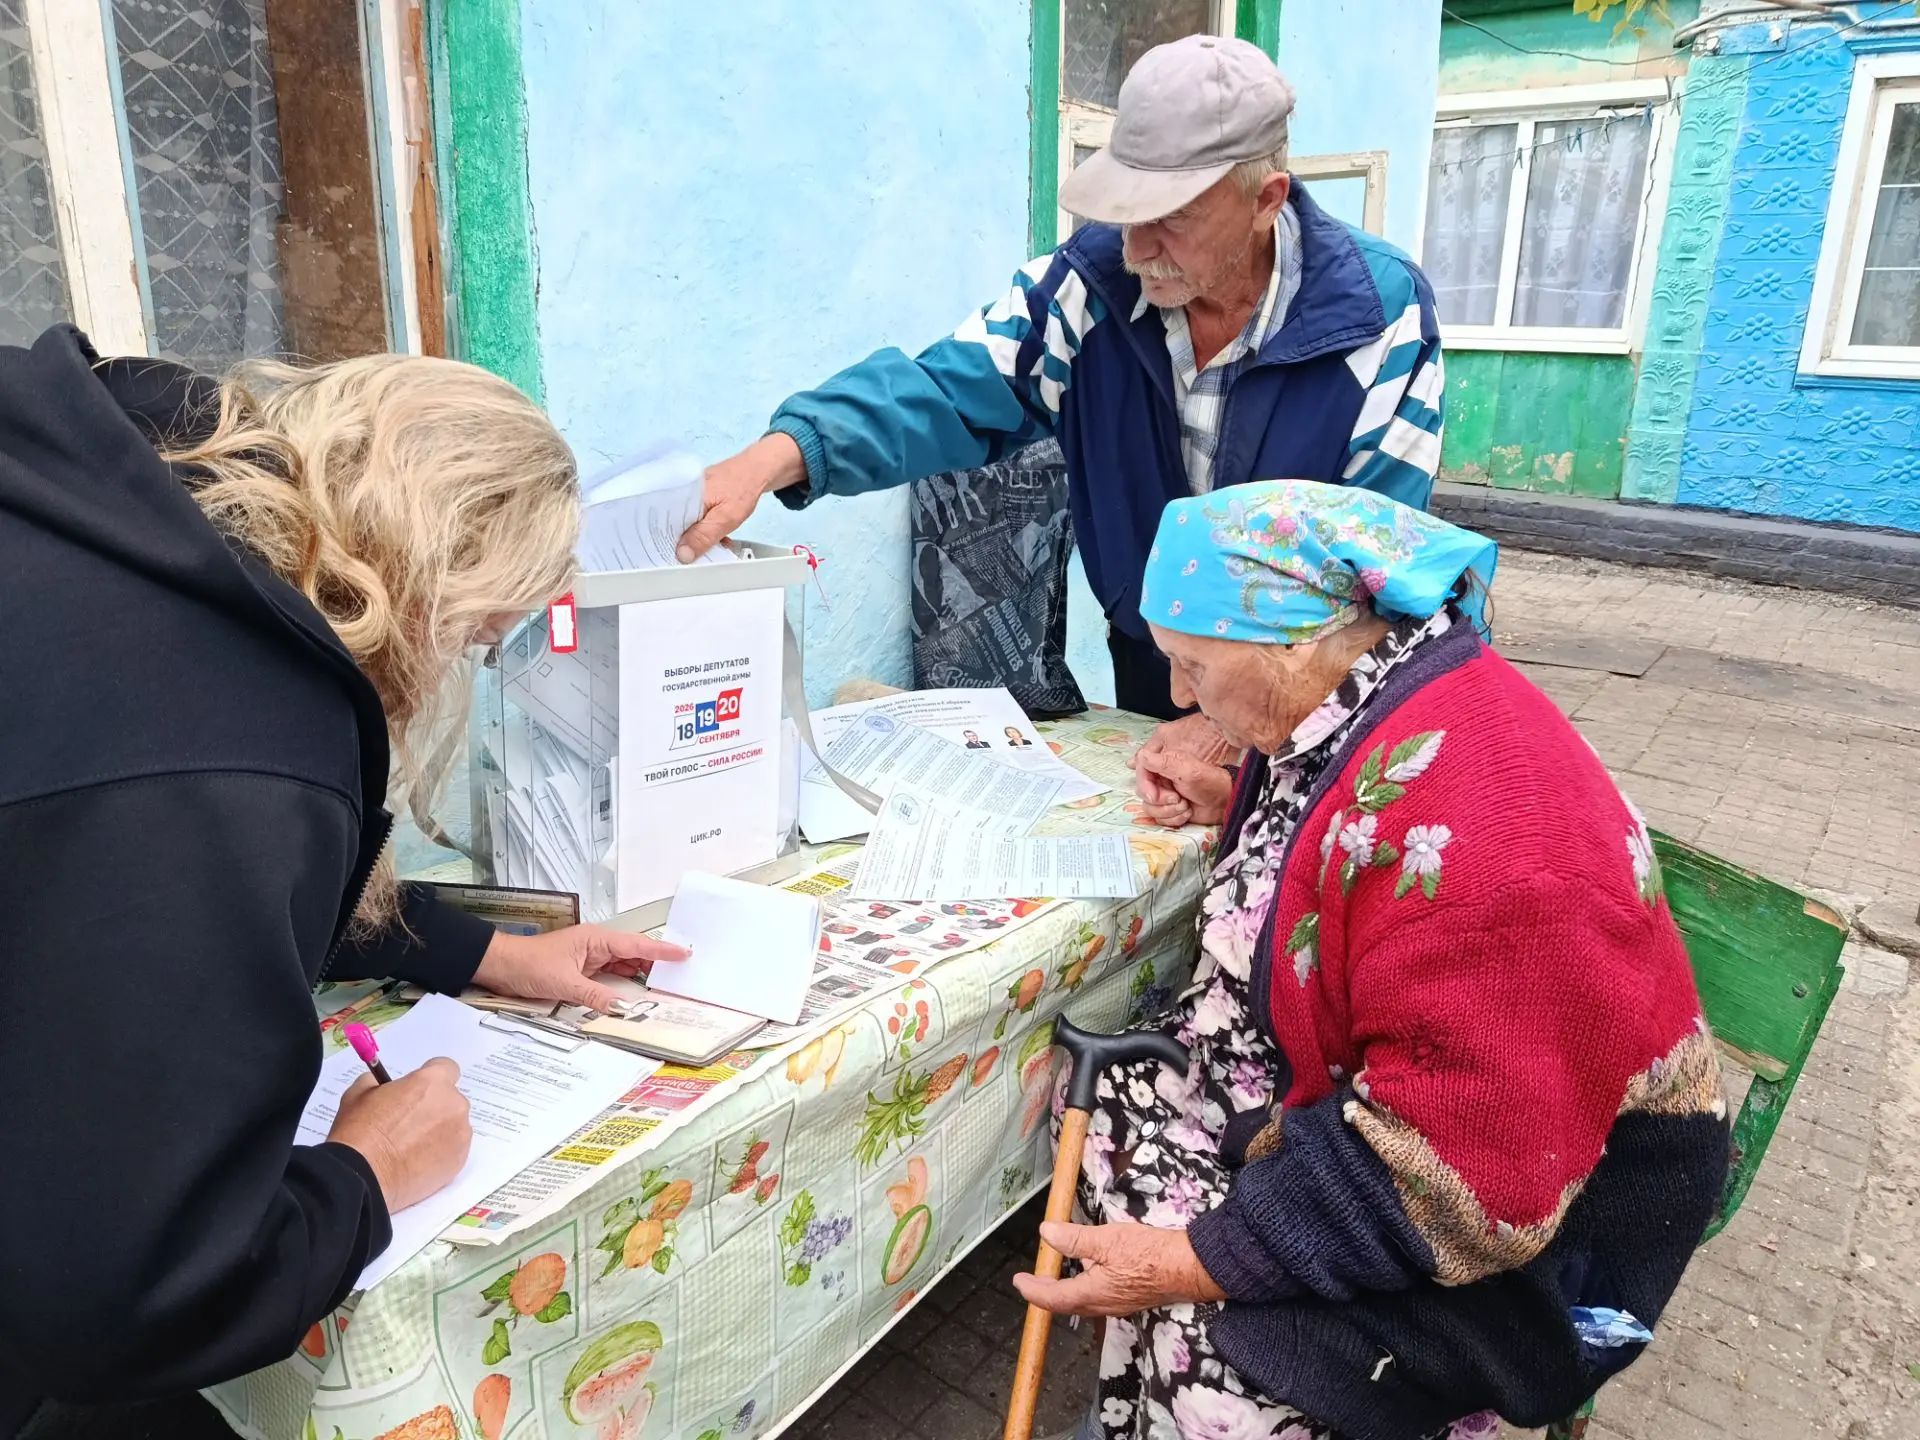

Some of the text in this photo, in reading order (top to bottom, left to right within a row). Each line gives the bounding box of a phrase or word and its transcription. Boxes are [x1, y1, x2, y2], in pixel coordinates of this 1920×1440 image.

[1000, 599, 1032, 651] NOUVELLES
[983, 605, 1024, 672] CHOQUANTES
[664, 657, 750, 678] ВЫБОРЫ ДЕПУТАТОВ
[662, 671, 751, 692] ГОСУДАРСТВЕННОЙ ДУМЫ
[674, 703, 695, 714] 2026
[677, 695, 738, 741] 18 19 20
[699, 729, 740, 744] СЕНТЯБРЯ
[644, 768, 669, 782] ТВОЙ
[670, 763, 699, 776] ГОЛОС
[707, 756, 730, 768] СИЛА
[731, 747, 763, 762] РОССИИ!
[690, 828, 722, 844] ЦИК.РФ
